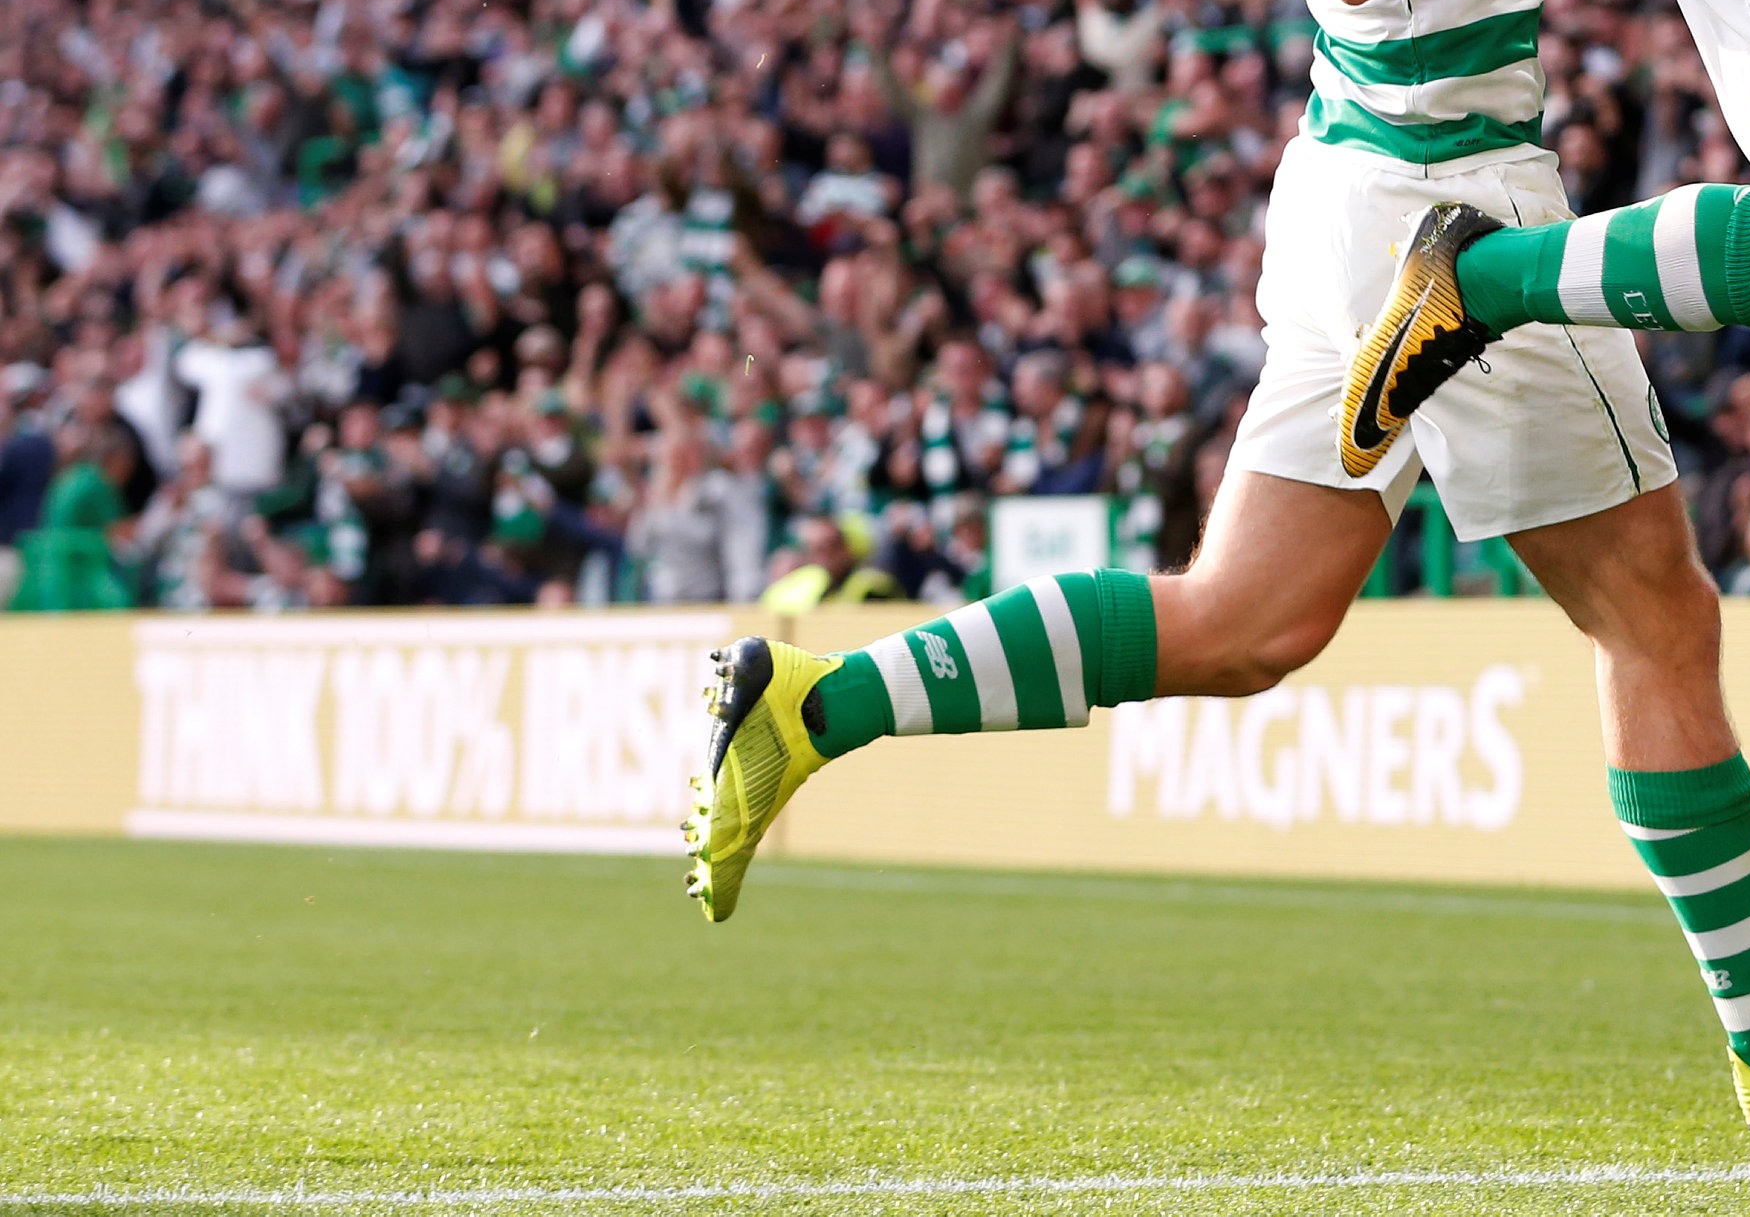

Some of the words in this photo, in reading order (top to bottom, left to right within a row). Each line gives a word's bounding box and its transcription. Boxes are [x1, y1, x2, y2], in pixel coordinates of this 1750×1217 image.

[136, 645, 326, 810] THINK
[330, 643, 514, 817] 100%
[520, 642, 708, 821] IRISH
[1106, 664, 1525, 831] MAGNERS
